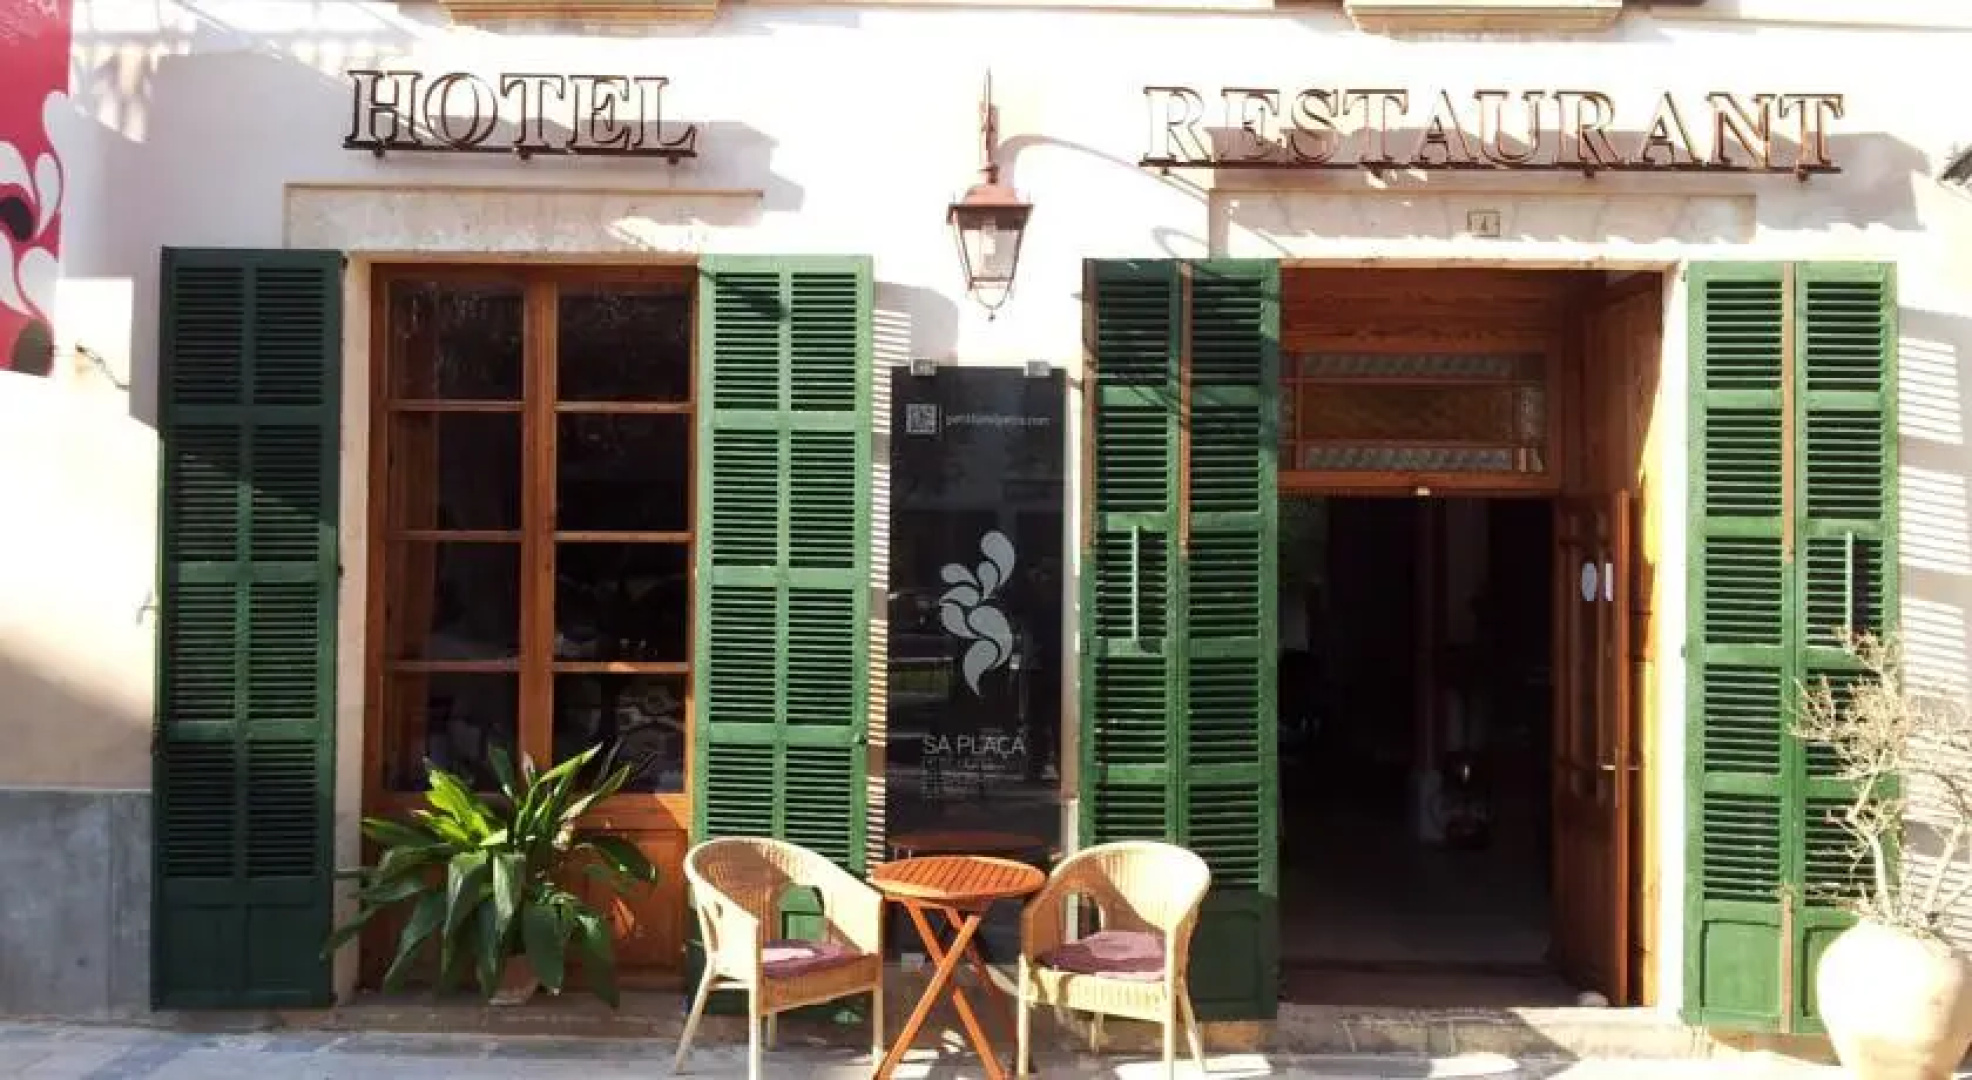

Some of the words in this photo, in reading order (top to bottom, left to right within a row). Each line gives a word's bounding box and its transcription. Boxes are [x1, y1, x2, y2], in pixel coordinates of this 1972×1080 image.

[345, 69, 698, 152] HOTEL
[1143, 86, 1845, 165] RESTAURANT
[922, 735, 950, 754] SA
[957, 735, 1026, 759] PLAÇA
